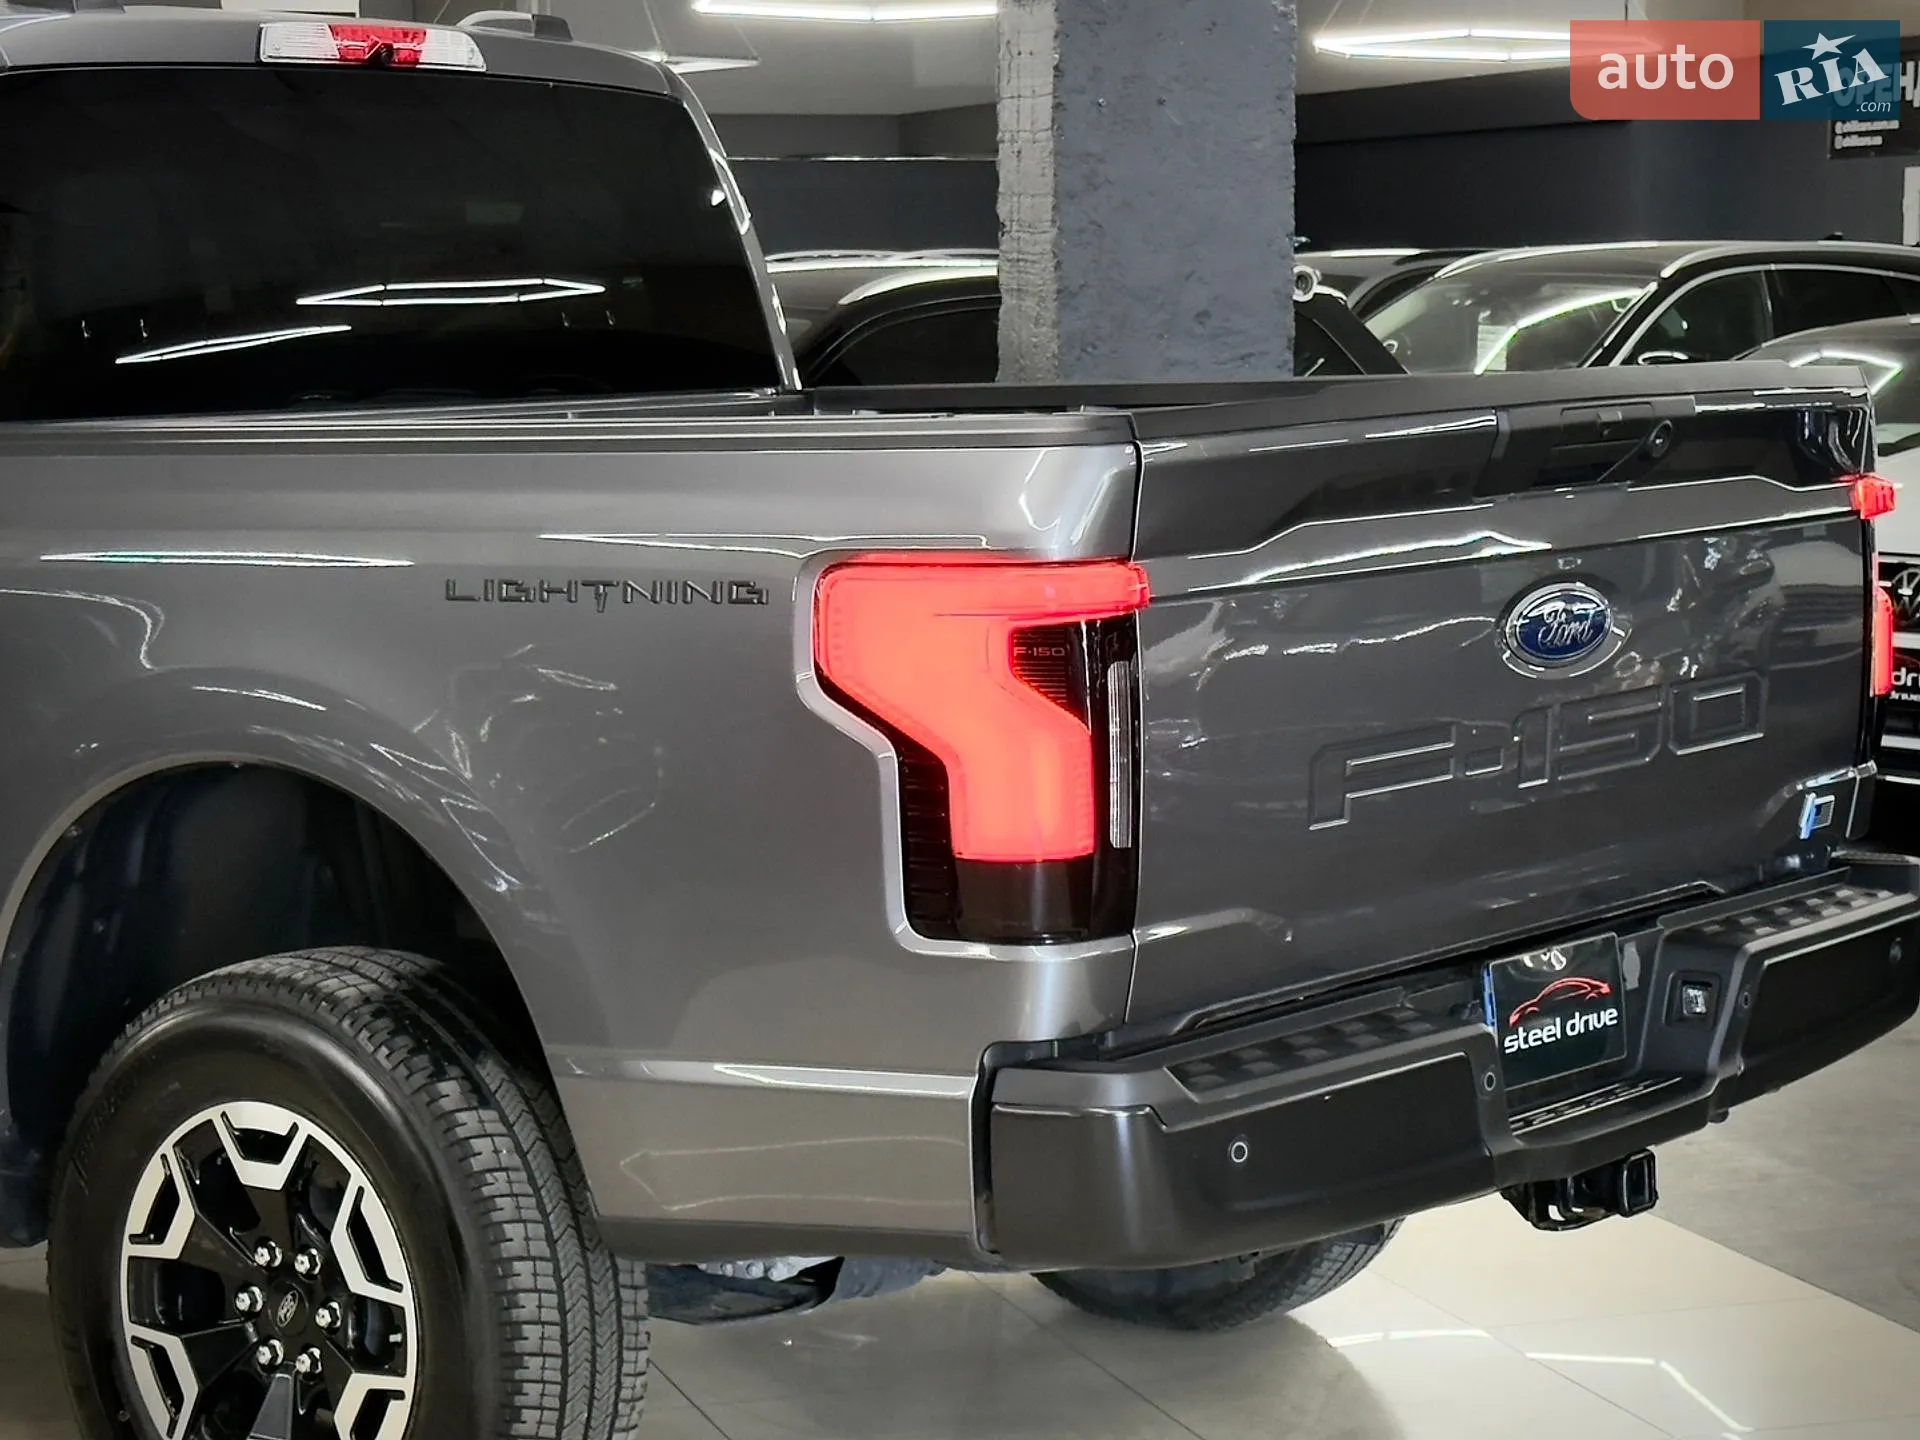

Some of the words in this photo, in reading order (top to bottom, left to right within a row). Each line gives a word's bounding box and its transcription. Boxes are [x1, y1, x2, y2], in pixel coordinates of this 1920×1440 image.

[445, 578, 769, 613] LIGHTNING
[1526, 601, 1602, 650] Ford
[1890, 666, 1920, 689] dr
[1310, 669, 1768, 831] F-150
[1503, 1016, 1561, 1055] steel
[1565, 1007, 1619, 1037] drive
